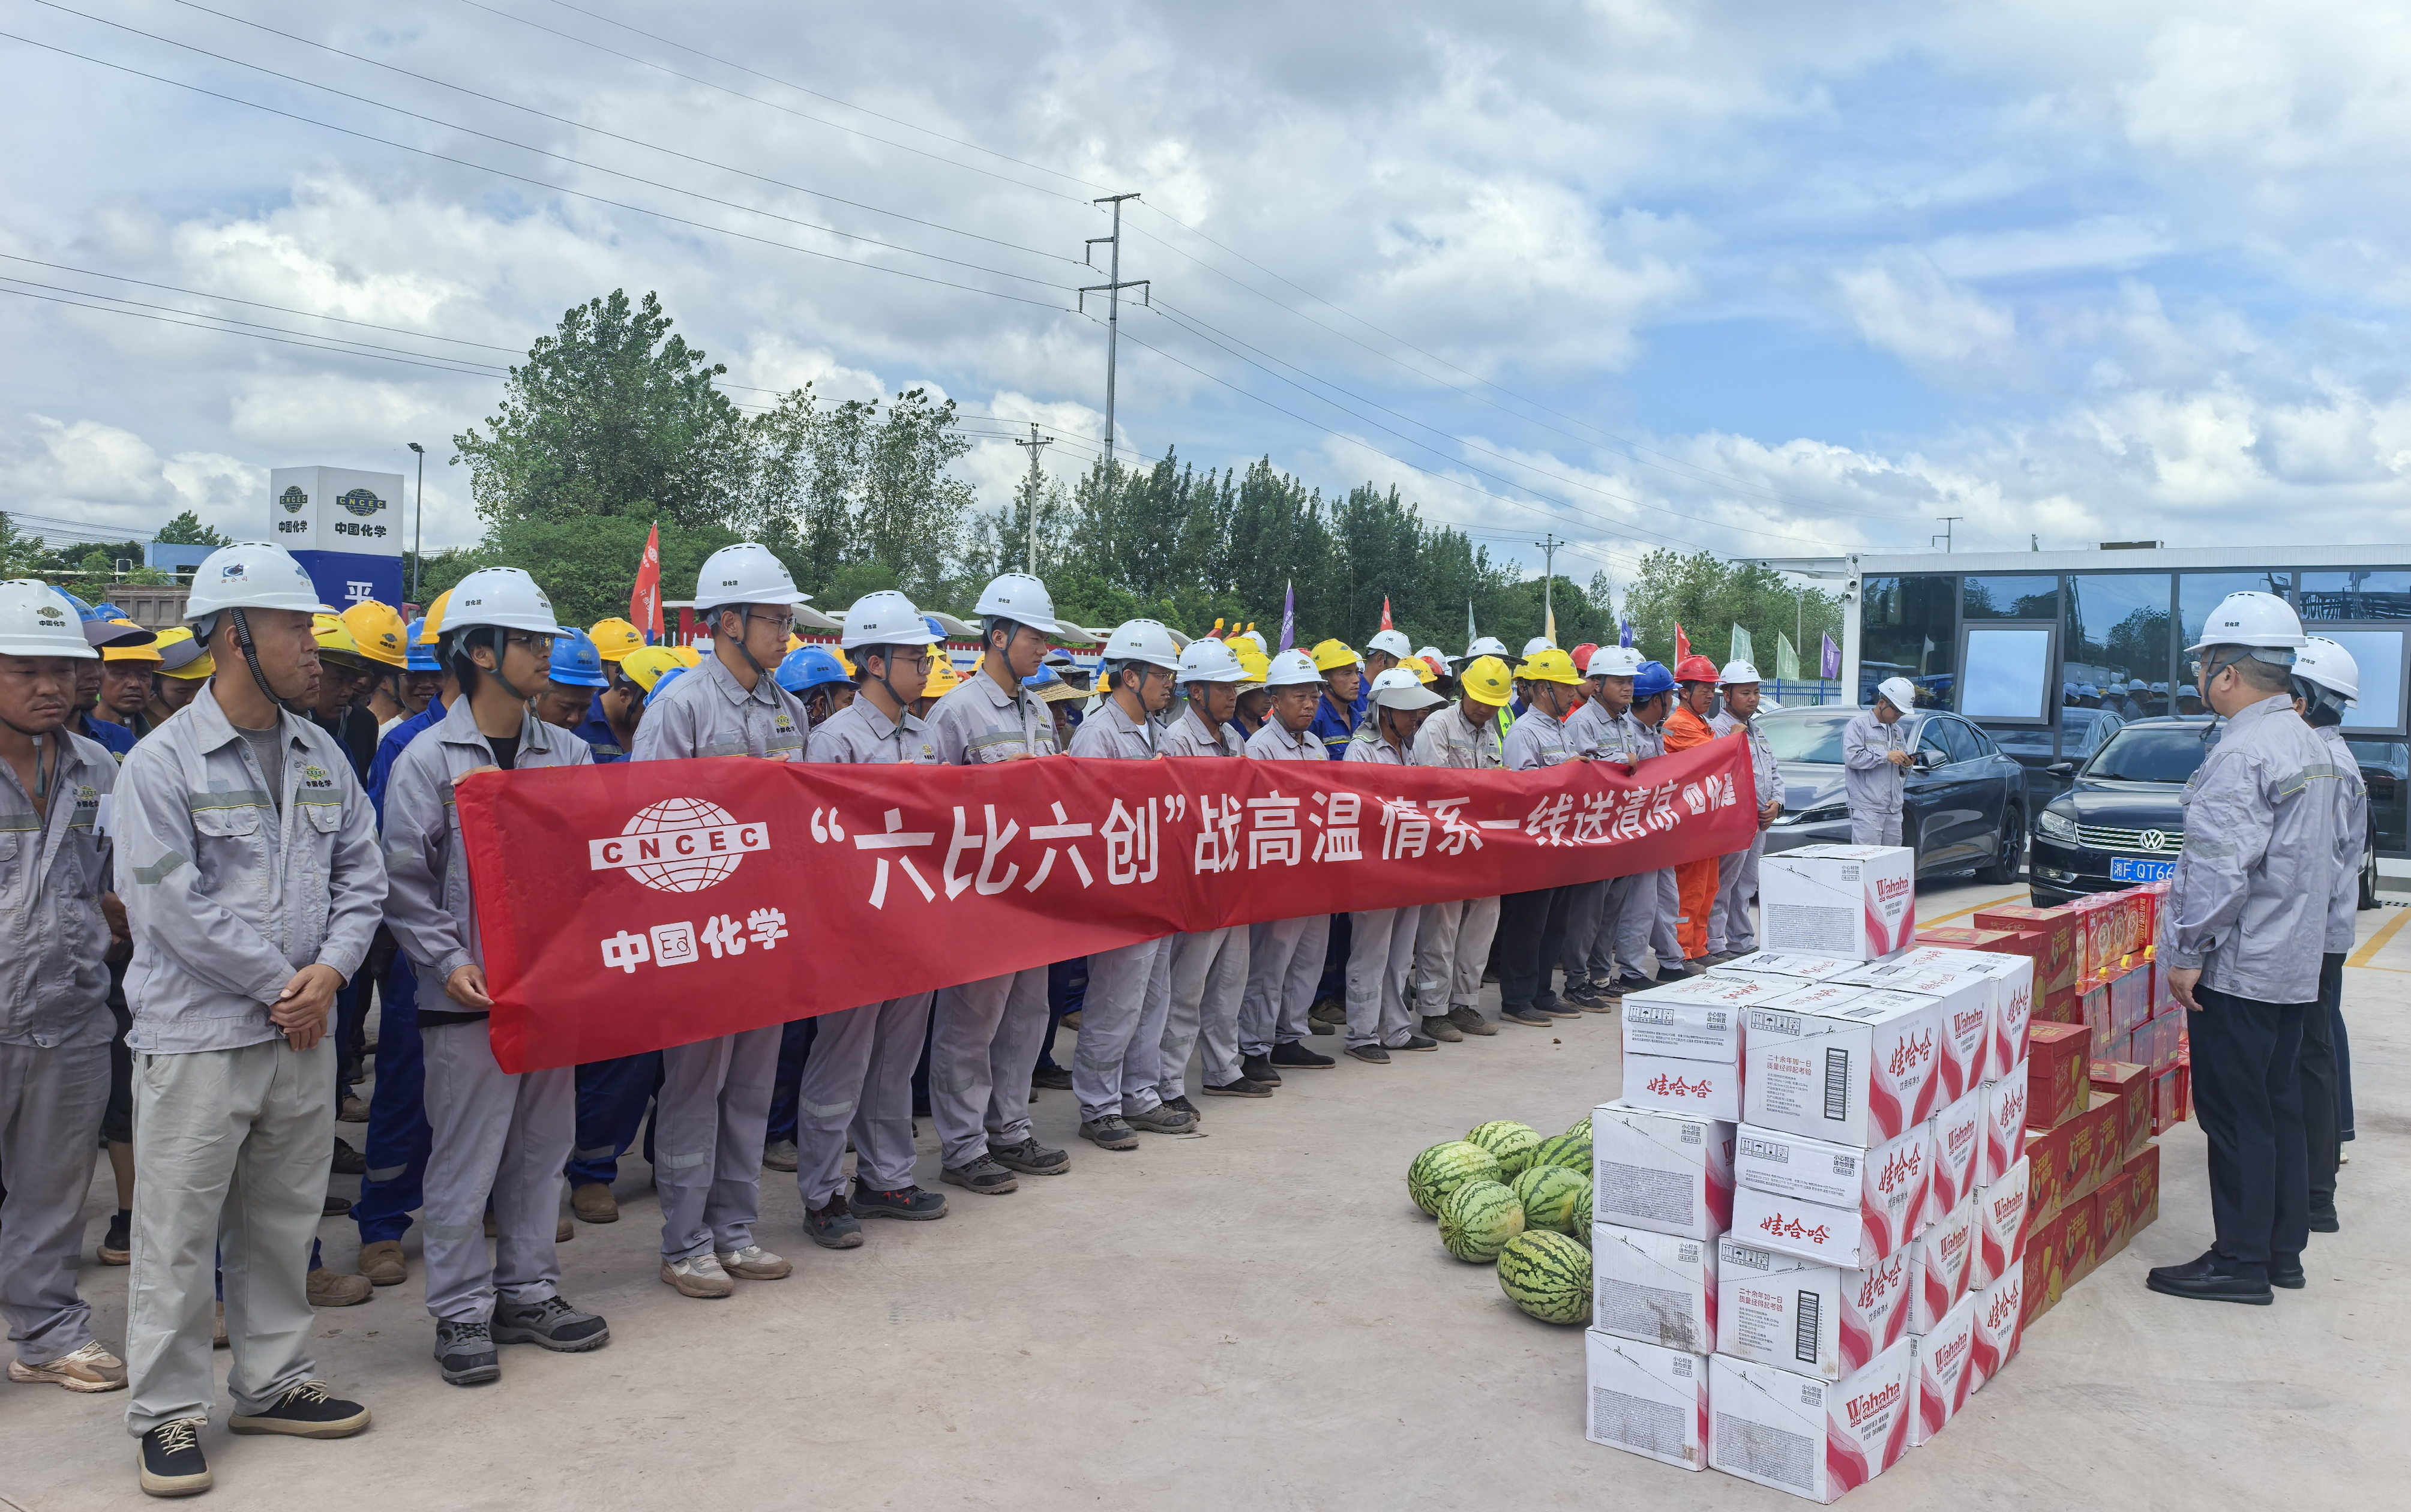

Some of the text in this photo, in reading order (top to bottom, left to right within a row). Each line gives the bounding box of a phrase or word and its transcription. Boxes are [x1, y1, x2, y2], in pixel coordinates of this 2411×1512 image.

[339, 497, 383, 508] CNCEC
[279, 520, 307, 533] 中国化学
[335, 522, 386, 538] 中国化学
[1376, 778, 1681, 860] 情系一线送清凉
[602, 827, 758, 863] CNCEC
[1876, 876, 1909, 902] Wahaha
[601, 907, 788, 974] 中国化学
[2007, 983, 2029, 1024] 娃哈哈
[1954, 1007, 1983, 1039] Wahaha
[1890, 1027, 1932, 1077] 娃哈哈
[1767, 1062, 1811, 1075] 质量经得起考验
[1647, 1073, 1713, 1099] 娃哈哈
[2000, 1084, 2023, 1128] 娃哈哈
[1948, 1120, 1974, 1156] Wahaha
[1834, 1155, 1855, 1163] 小心轻放
[1834, 1160, 1855, 1169] 请勿倒置
[1879, 1142, 1920, 1193] 娃哈哈
[1994, 1192, 2023, 1224] Wahaha
[1760, 1213, 1830, 1244] 娃哈哈
[1941, 1225, 1968, 1262] Wahaha
[1739, 1288, 1782, 1303] 二十余年如一日
[1858, 1253, 1902, 1309] 娃哈哈
[1739, 1295, 1783, 1312] 质量经得起考验
[1988, 1279, 2019, 1329] 娃哈哈
[1935, 1333, 1967, 1375] Wahaha
[1802, 1384, 1822, 1394] 小心轻放
[1802, 1390, 1822, 1399] 请勿倒置
[1846, 1382, 1901, 1427] Wahaha
